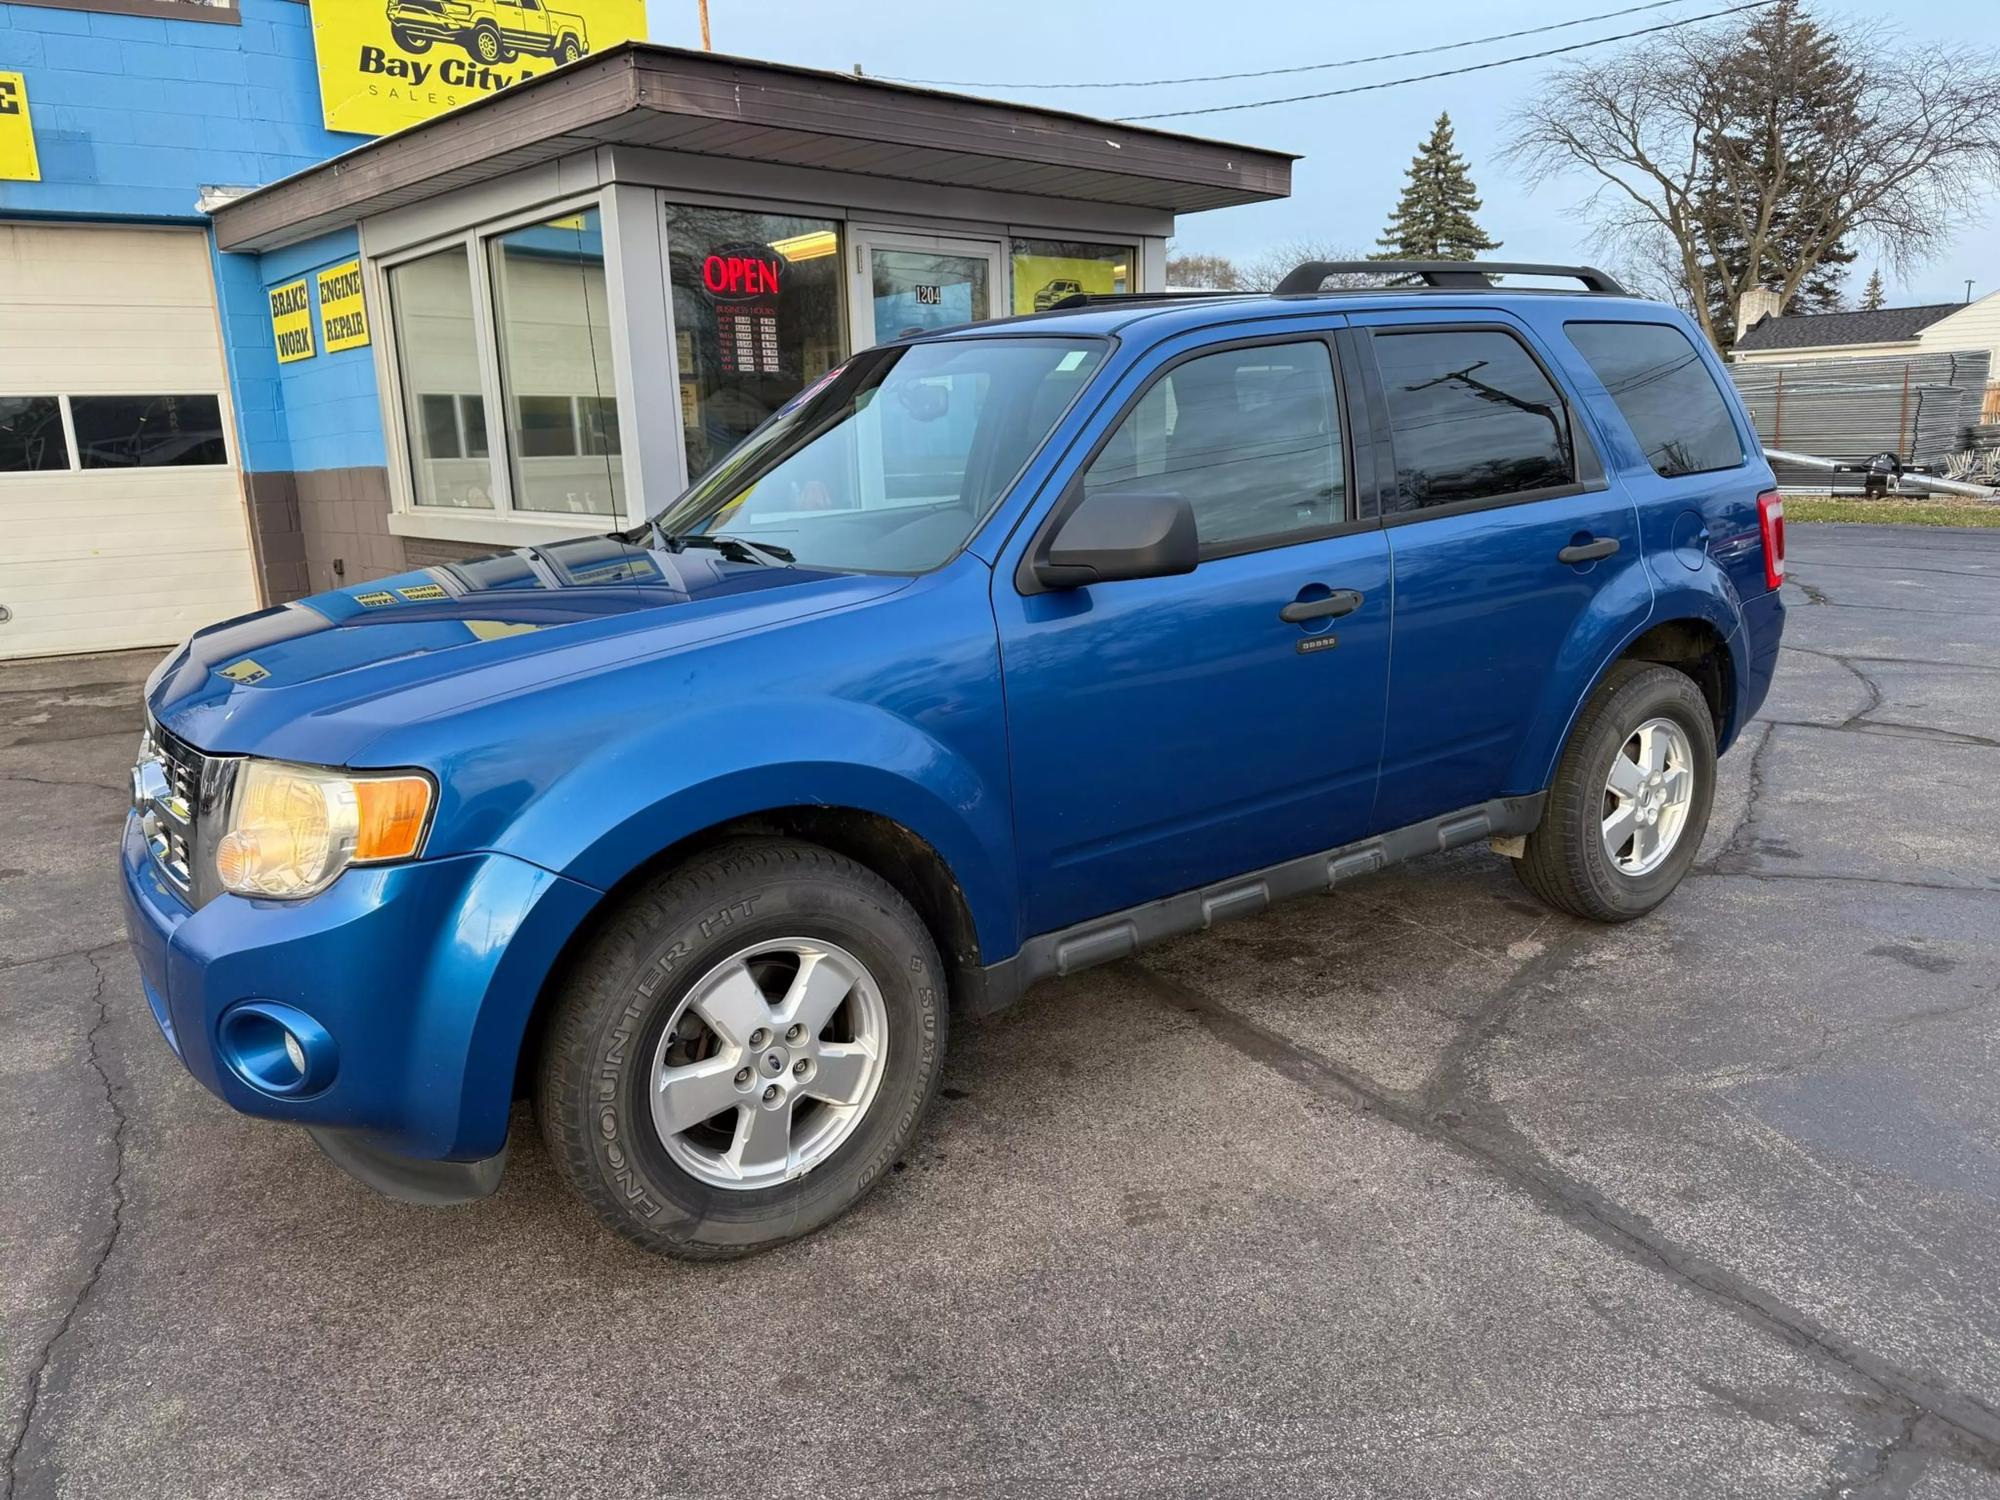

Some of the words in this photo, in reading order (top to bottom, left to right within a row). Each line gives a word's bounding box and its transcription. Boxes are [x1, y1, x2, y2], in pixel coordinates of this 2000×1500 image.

[359, 45, 433, 86] Bay
[439, 59, 512, 91] City
[369, 85, 456, 106] SALES
[320, 271, 360, 304] ENGINE
[703, 255, 778, 294] OPEN
[271, 285, 307, 318] BRAKE
[916, 286, 941, 304] 1204
[277, 327, 310, 357] WORK
[325, 311, 365, 342] REPAIR
[599, 940, 695, 1220] ENCOUNTER
[698, 893, 762, 940] HT
